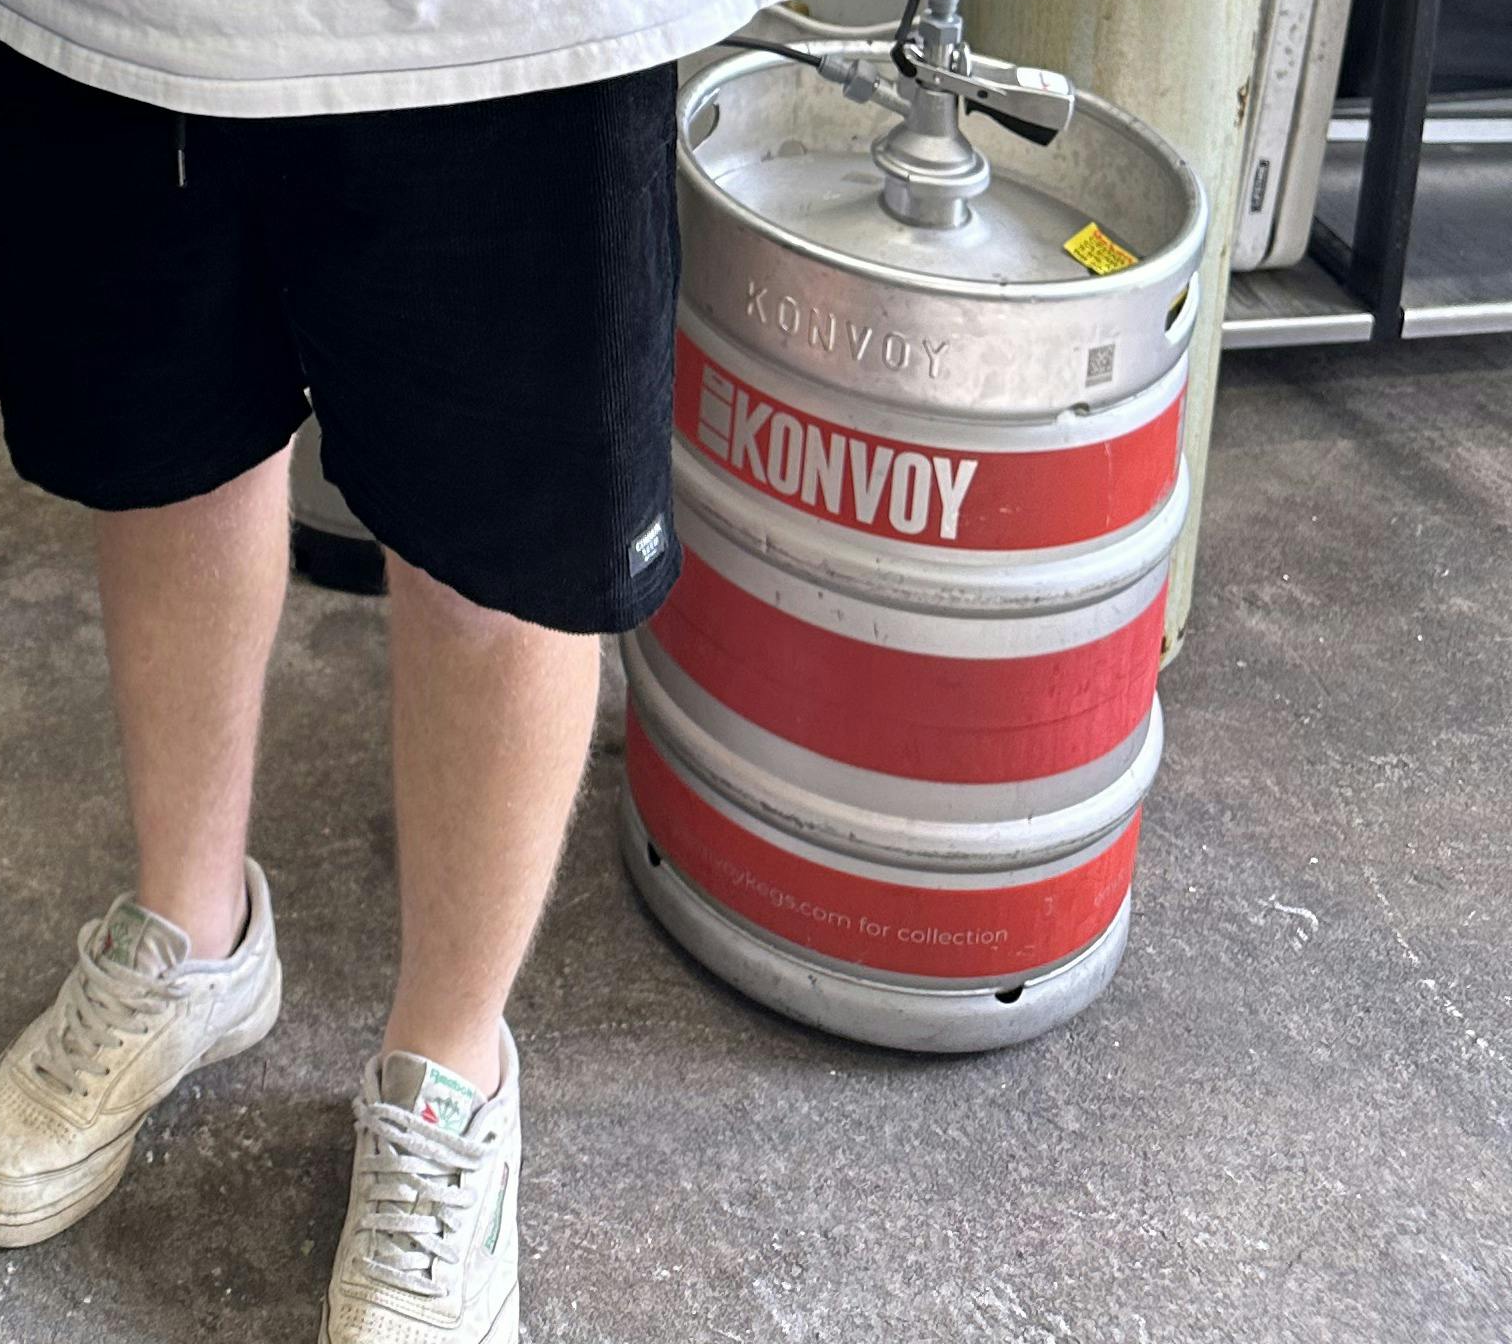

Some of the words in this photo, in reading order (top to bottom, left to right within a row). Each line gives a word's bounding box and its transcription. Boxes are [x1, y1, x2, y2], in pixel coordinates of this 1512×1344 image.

[746, 281, 950, 379] KONVOY
[731, 389, 979, 541] KONVOY
[860, 916, 889, 937] for
[897, 921, 1009, 946] collection
